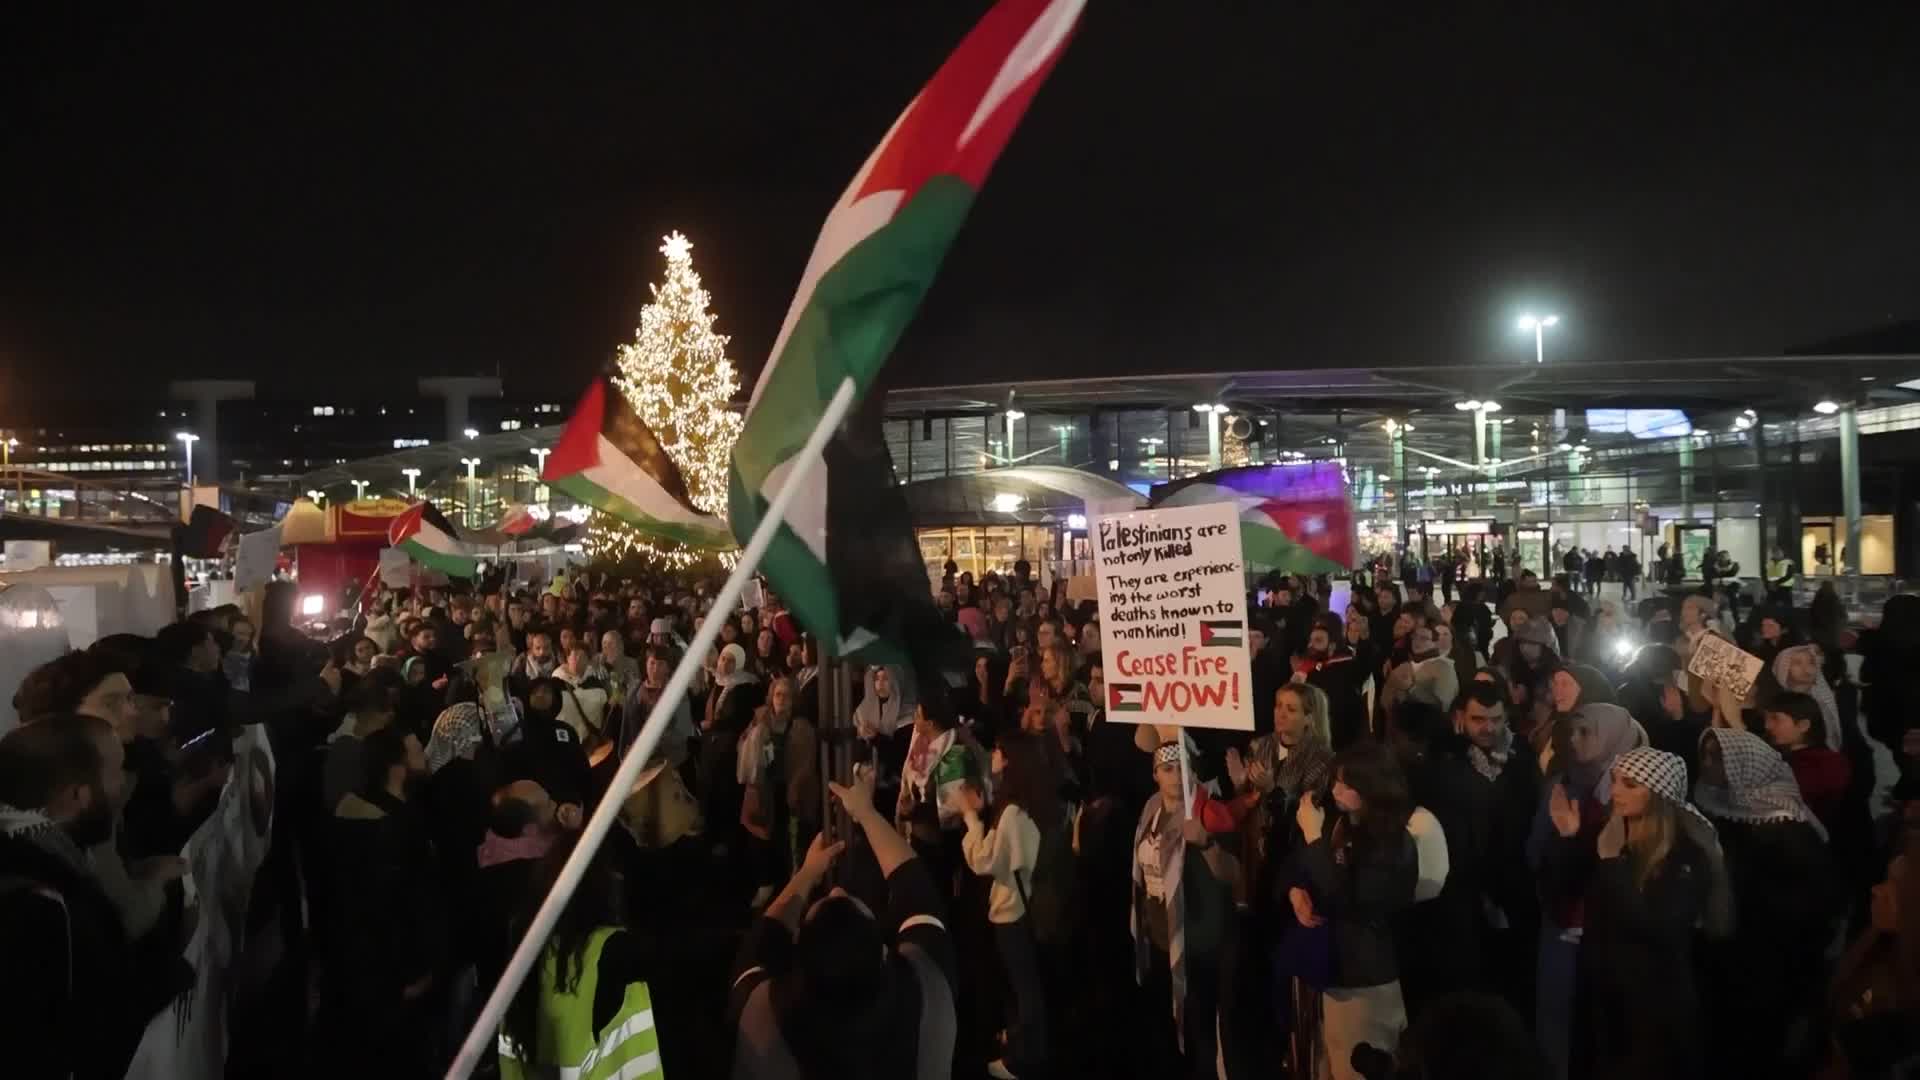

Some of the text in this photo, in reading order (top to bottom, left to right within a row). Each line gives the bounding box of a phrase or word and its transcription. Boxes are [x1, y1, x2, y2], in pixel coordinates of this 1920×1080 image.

[1099, 520, 1193, 552] Palestinians
[1197, 523, 1227, 538] are
[1106, 560, 1241, 591] They are experienc-
[1109, 582, 1202, 606] ing the worst
[1110, 600, 1234, 622] deaths known to
[1116, 646, 1229, 677] Cease Fire
[1141, 671, 1239, 713] NOW!
